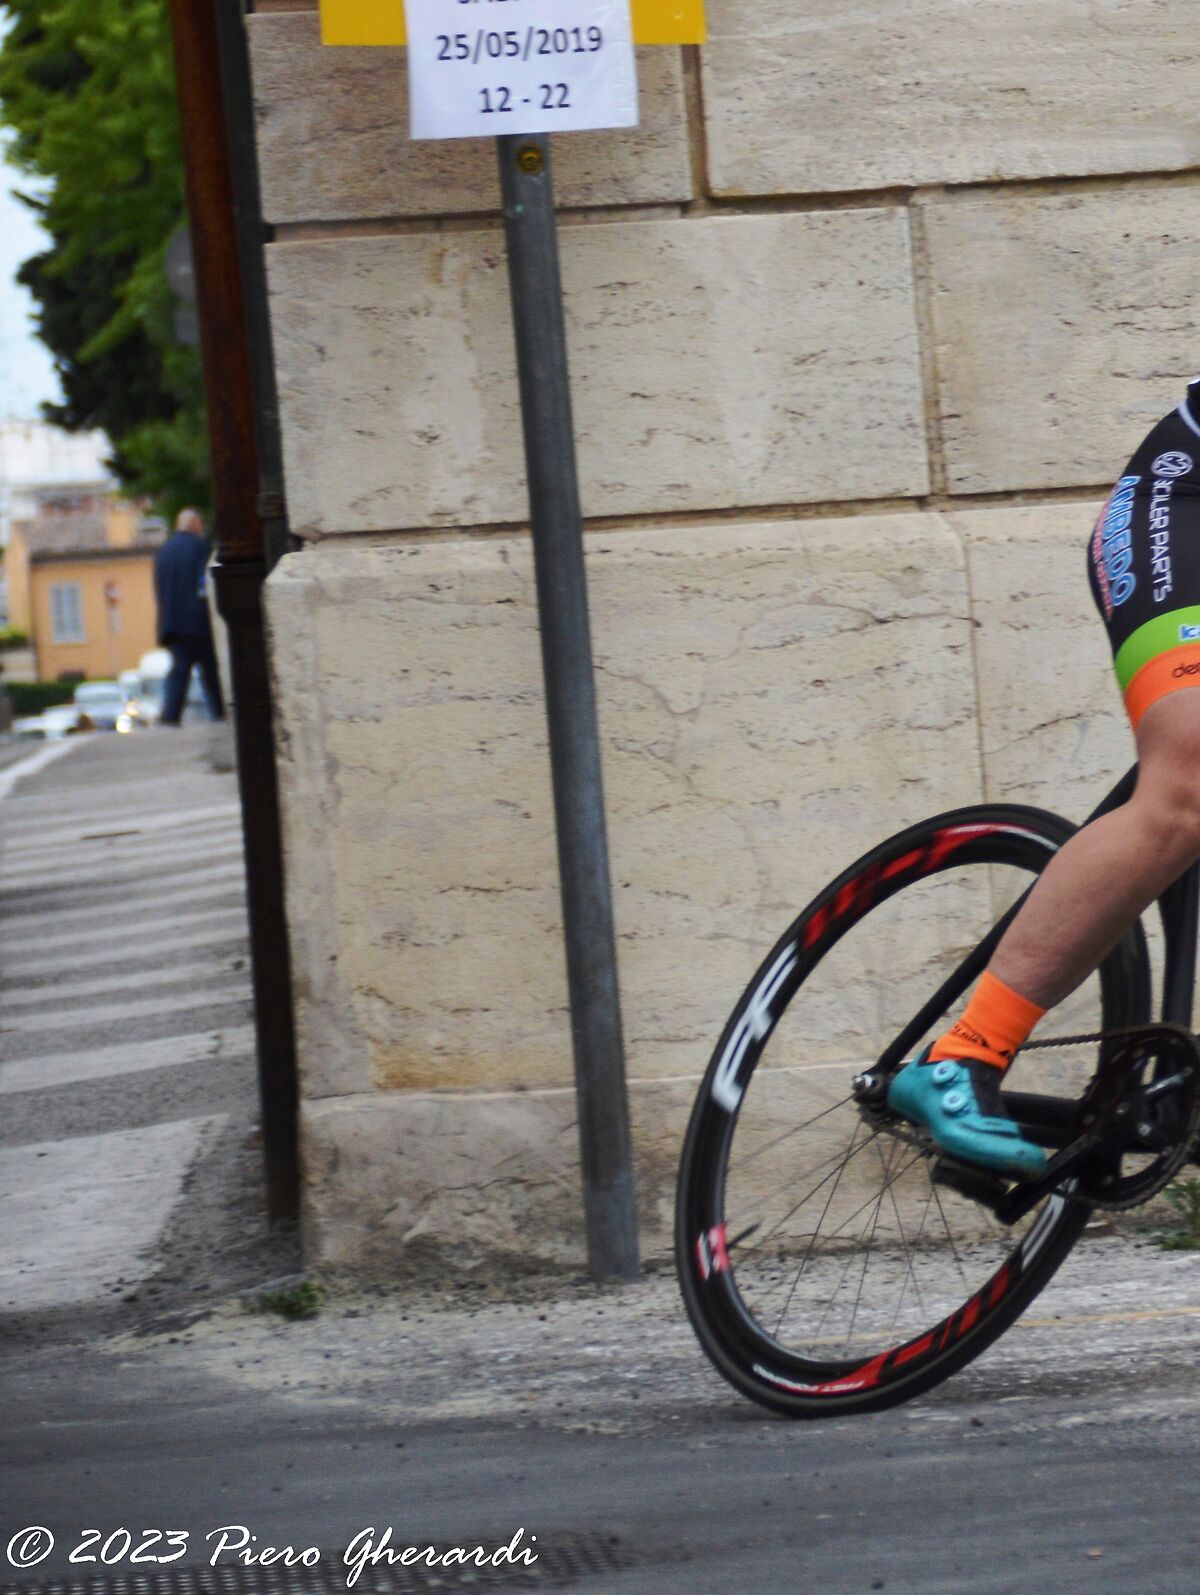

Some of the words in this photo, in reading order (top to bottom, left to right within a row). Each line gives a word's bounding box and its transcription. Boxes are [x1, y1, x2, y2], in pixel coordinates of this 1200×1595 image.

[436, 26, 602, 64] 25/05/2019
[480, 87, 513, 113] 12
[540, 83, 571, 109] 22
[1149, 531, 1175, 602] PARTS
